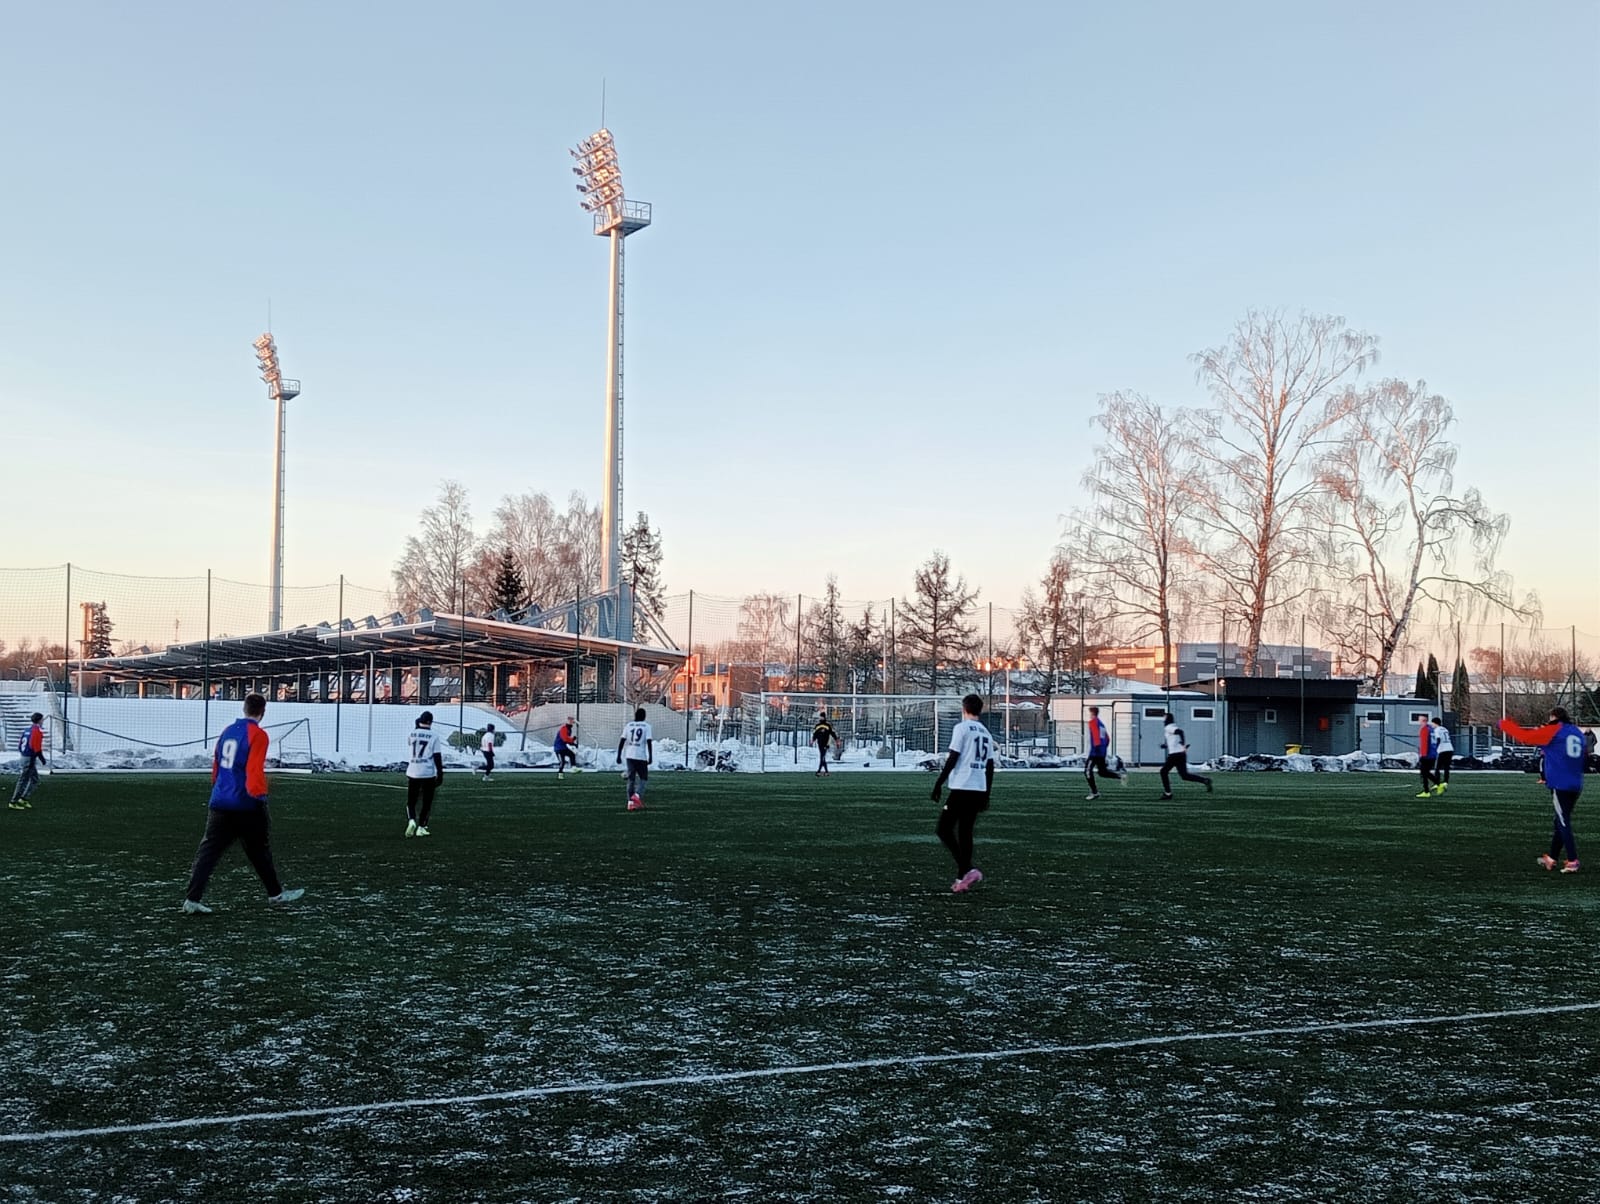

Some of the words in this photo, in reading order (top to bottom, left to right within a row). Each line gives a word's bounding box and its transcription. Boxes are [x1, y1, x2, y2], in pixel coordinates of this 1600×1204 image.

[630, 728, 643, 742] 19
[1566, 734, 1582, 758] 6
[220, 739, 238, 769] 9
[412, 740, 429, 759] 17
[974, 736, 989, 761] 15
